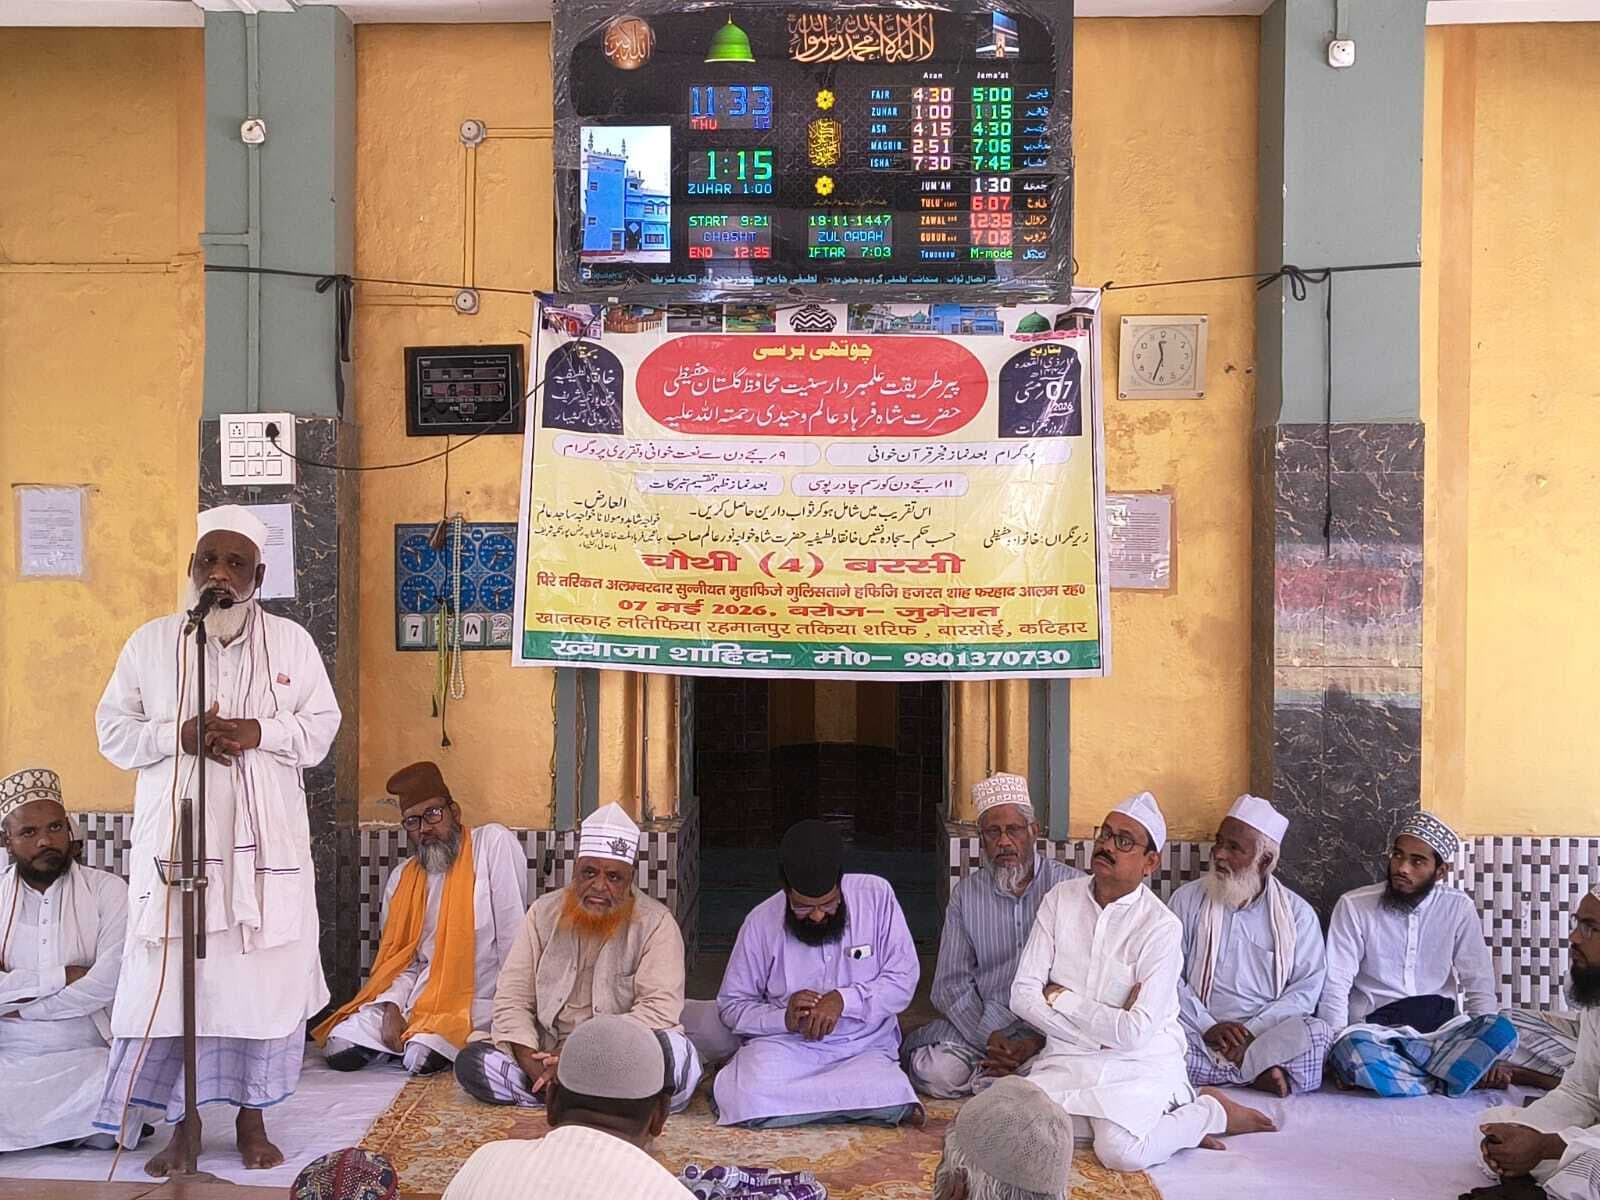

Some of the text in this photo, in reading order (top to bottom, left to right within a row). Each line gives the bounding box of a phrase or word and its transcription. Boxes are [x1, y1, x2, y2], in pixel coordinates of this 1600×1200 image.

[690, 86, 770, 115] 11:33
[913, 88, 951, 102] 4:30
[973, 88, 1011, 102] 5:00
[871, 105, 1011, 119] ZUHAR 1:00 1:15
[691, 118, 718, 130] THU
[871, 122, 1011, 136] ASR 4:15 4:30
[913, 139, 950, 153] 2:51
[973, 139, 1010, 153] 7:06
[707, 151, 773, 180] 1:15
[913, 156, 951, 170] 7:30
[973, 156, 1011, 170] 7:45
[688, 183, 772, 194] ZUHAR 1:00
[921, 178, 1011, 192] JUM'AH 1:30
[689, 216, 768, 227] START 9:21
[921, 216, 946, 225] ZAWAL
[818, 231, 840, 242] ZUL
[689, 247, 769, 258] END 12:25
[809, 247, 891, 258] IFTAR 7:03
[970, 248, 1014, 259] M-mode
[753, 340, 873, 364] چوتھی برسی
[691, 366, 748, 396] گلستان
[742, 372, 781, 394] محافظ
[880, 370, 943, 400] طریقت
[1046, 381, 1073, 400] 07
[808, 399, 839, 433] عالم
[875, 404, 903, 425] شاہ
[903, 406, 961, 430] حضرت
[723, 451, 744, 461] دن
[888, 480, 910, 491] دن
[833, 502, 860, 520] شامل
[859, 504, 878, 520] میں
[759, 551, 825, 579] (4)
[843, 552, 966, 574] बरसी
[559, 572, 602, 589] तरिकत
[729, 582, 783, 601] मुहाफिजे
[902, 586, 943, 599] हजरत
[946, 587, 972, 599] शाह
[975, 586, 1015, 599] फरहाद
[1019, 585, 1059, 597] आलम
[618, 598, 1001, 624] 07 मई जुमेरात
[536, 612, 612, 630] खानकाह
[617, 615, 701, 633] लतिफिया
[707, 621, 791, 639] रहमानपुर
[796, 620, 856, 636] तकिया
[1018, 619, 1088, 637] कटिहार
[903, 649, 1071, 667] 9801370730
